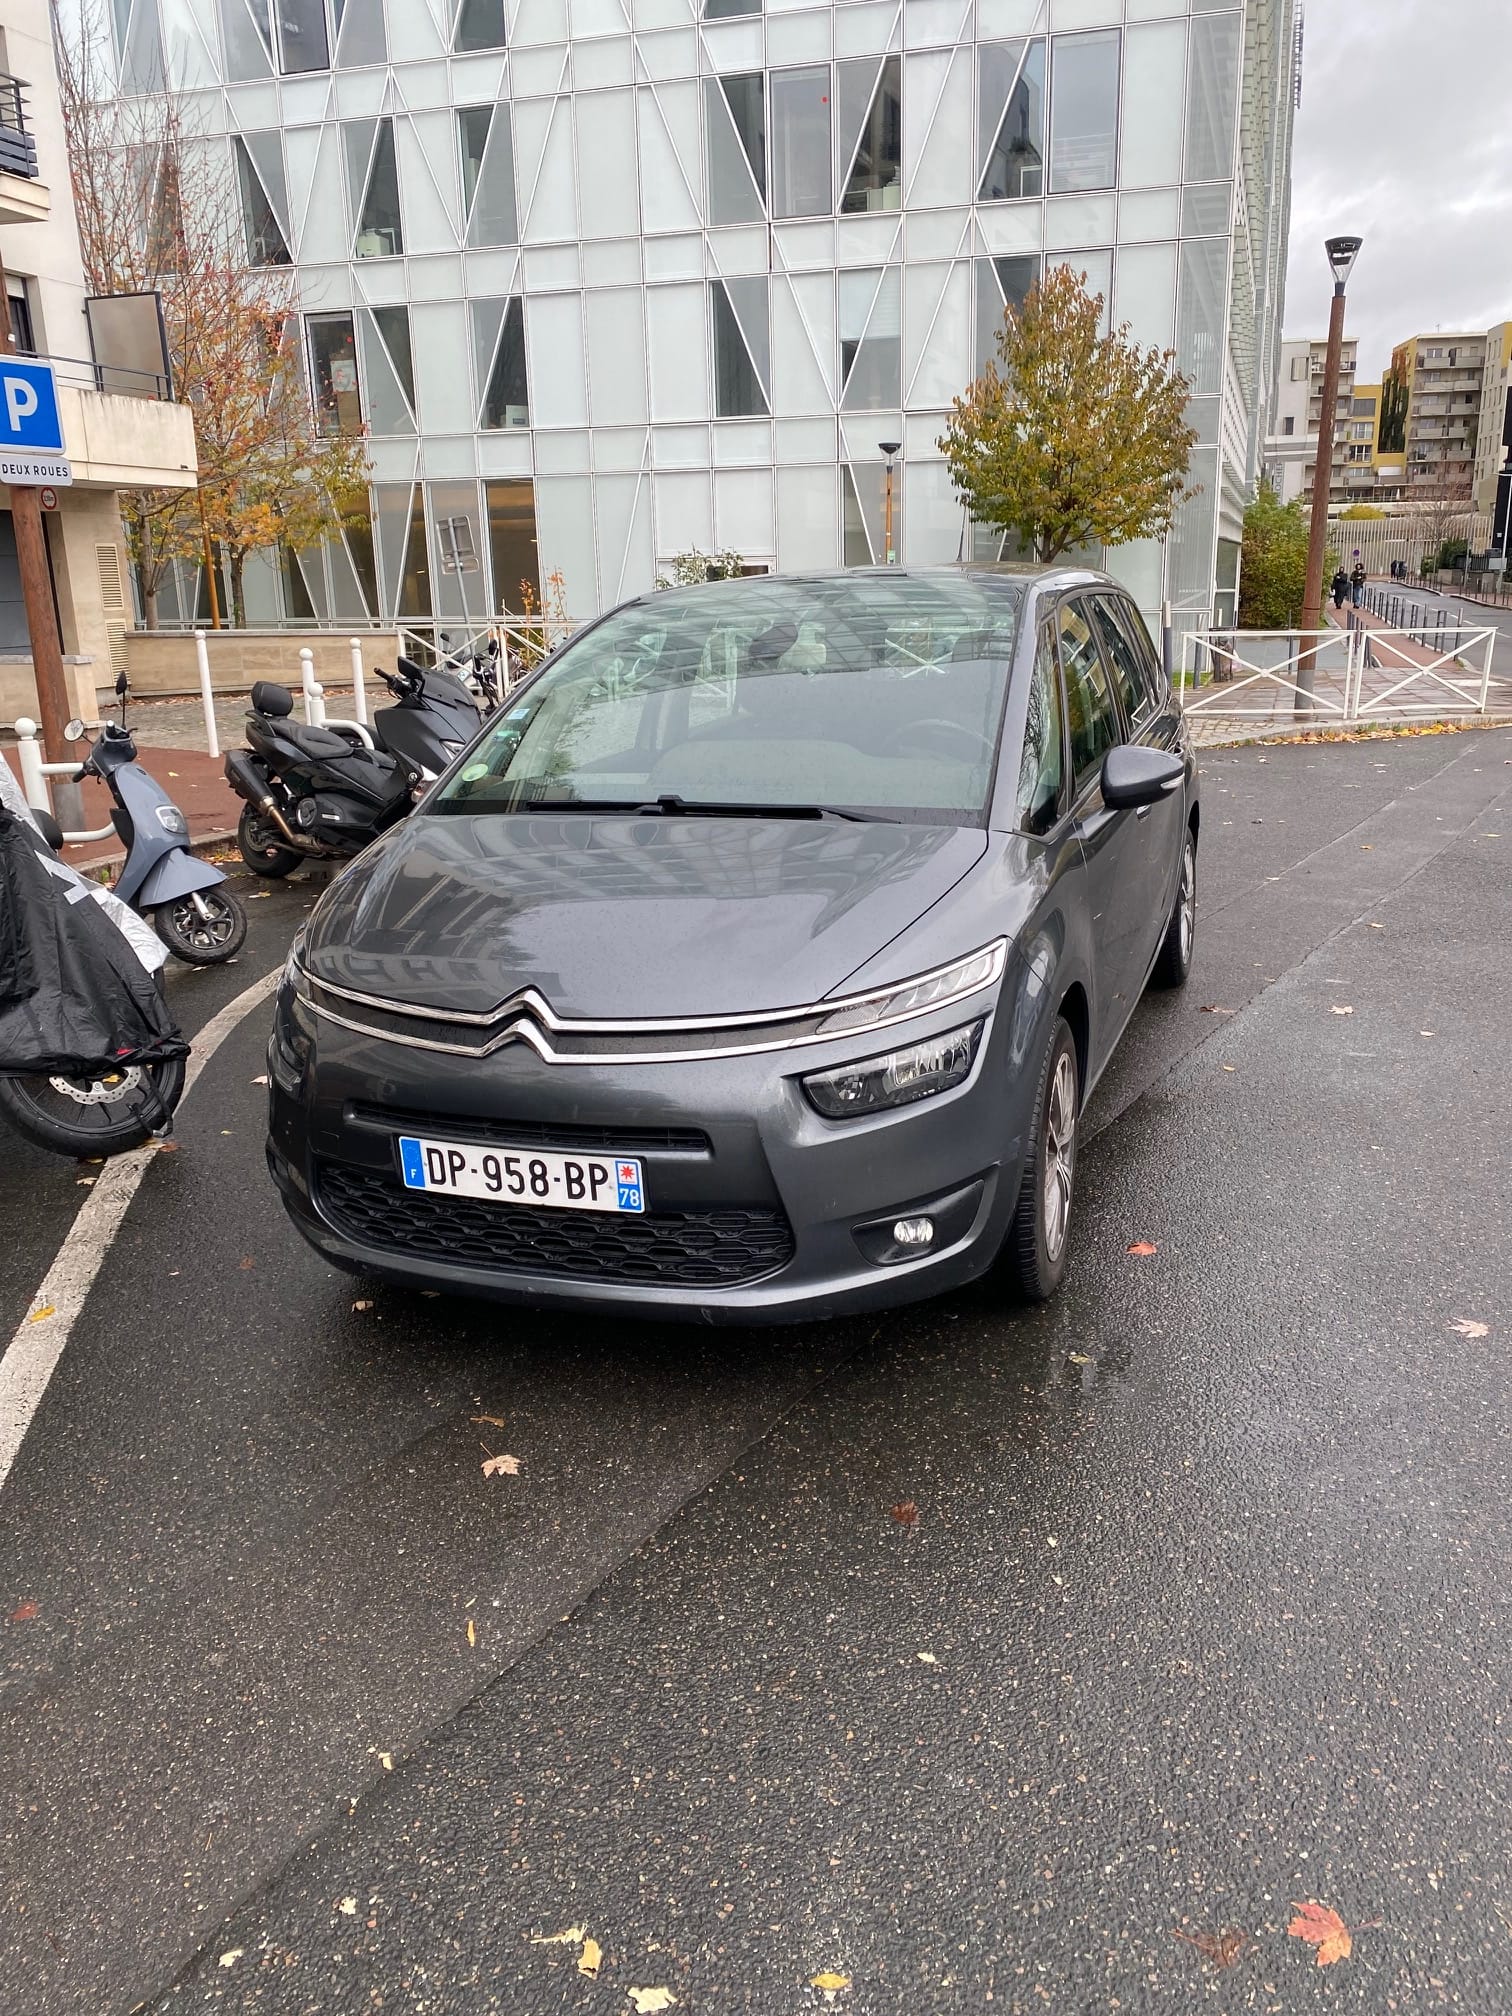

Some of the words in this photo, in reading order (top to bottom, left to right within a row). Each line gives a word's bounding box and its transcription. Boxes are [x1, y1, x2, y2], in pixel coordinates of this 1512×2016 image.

[3, 377, 38, 431] P
[1, 463, 31, 475] DEUX
[33, 465, 68, 477] ROUES
[410, 1168, 417, 1180] F
[426, 1147, 608, 1201] DP-958-BP
[619, 1187, 640, 1207] 78
